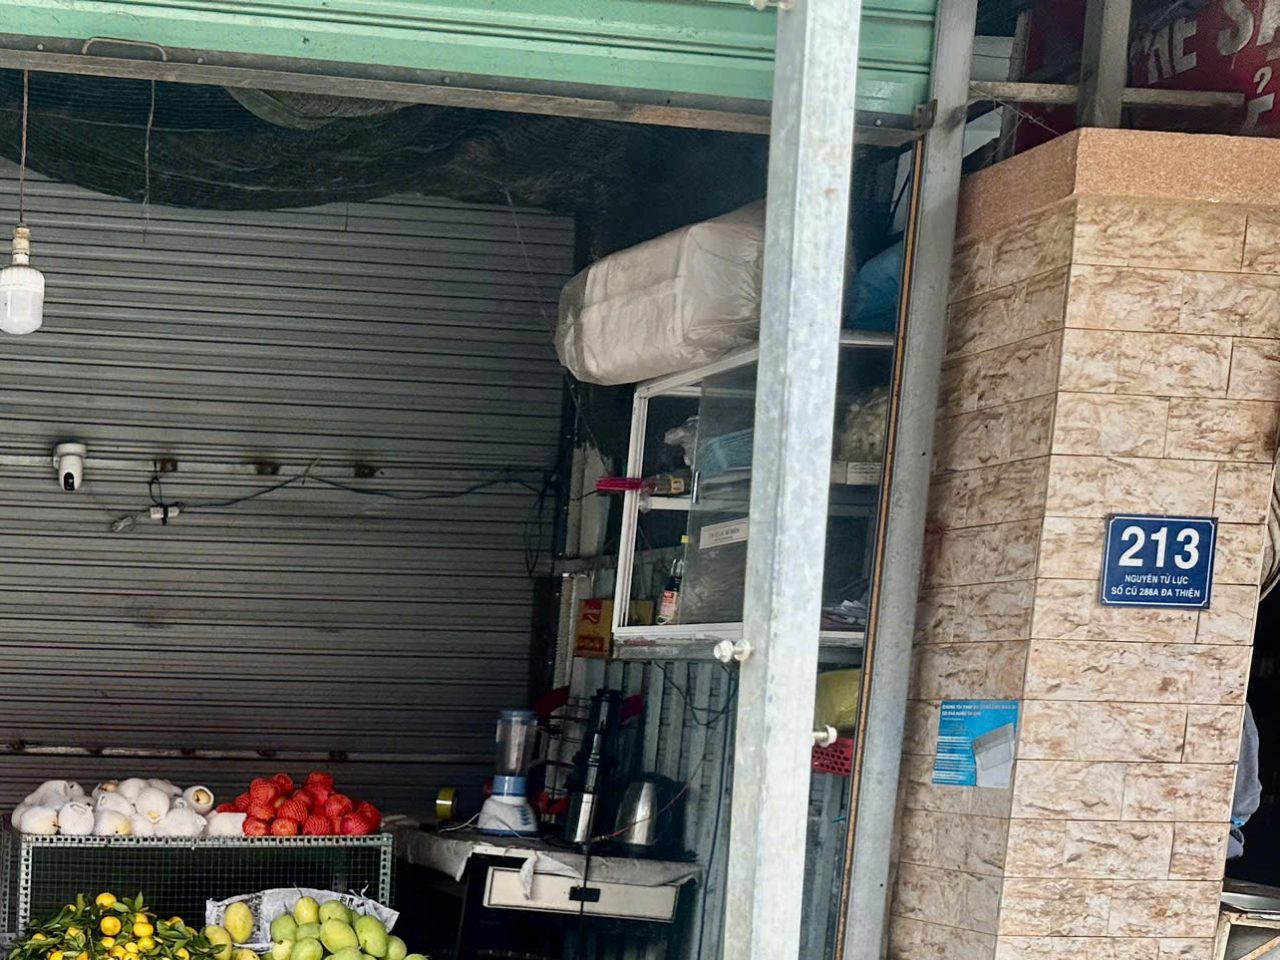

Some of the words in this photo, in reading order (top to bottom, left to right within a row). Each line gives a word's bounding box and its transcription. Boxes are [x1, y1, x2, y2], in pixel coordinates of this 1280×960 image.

[1118, 526, 1200, 570] 213
[1125, 574, 1158, 584] NGUYÊN
[1172, 575, 1189, 585] LỰC
[1111, 584, 1124, 595] SỐ
[1125, 586, 1137, 595] CŨ
[1161, 588, 1173, 597] ĐA
[1175, 588, 1200, 598] THIỆN
